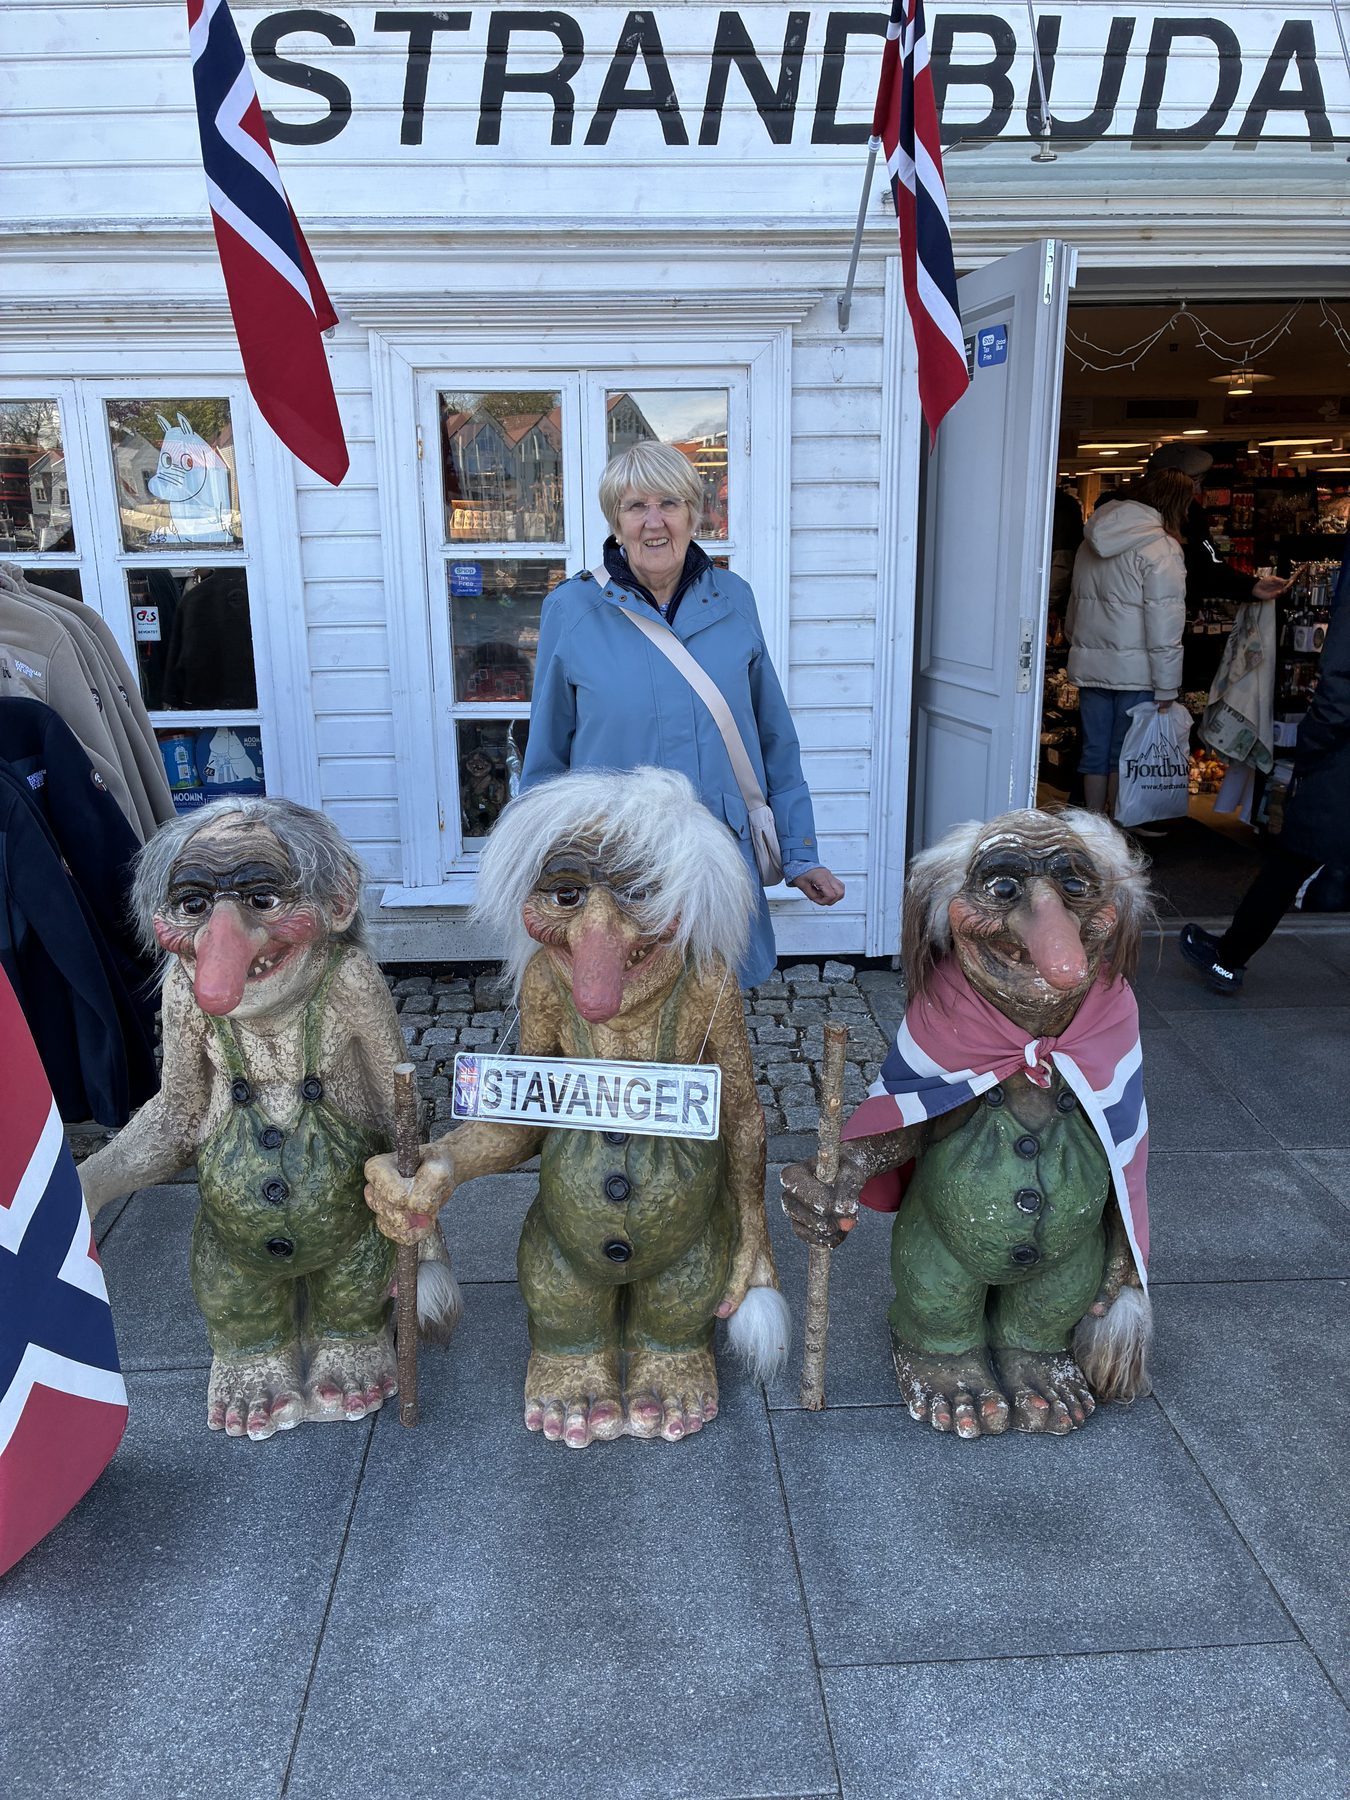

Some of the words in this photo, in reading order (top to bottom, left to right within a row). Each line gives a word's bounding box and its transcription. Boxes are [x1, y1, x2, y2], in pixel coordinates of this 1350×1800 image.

[251, 9, 1335, 151] STRANDBUDA
[173, 792, 203, 802] MOOMIN
[1212, 963, 1233, 979] HOKA
[482, 1069, 709, 1126] STAVANGER
